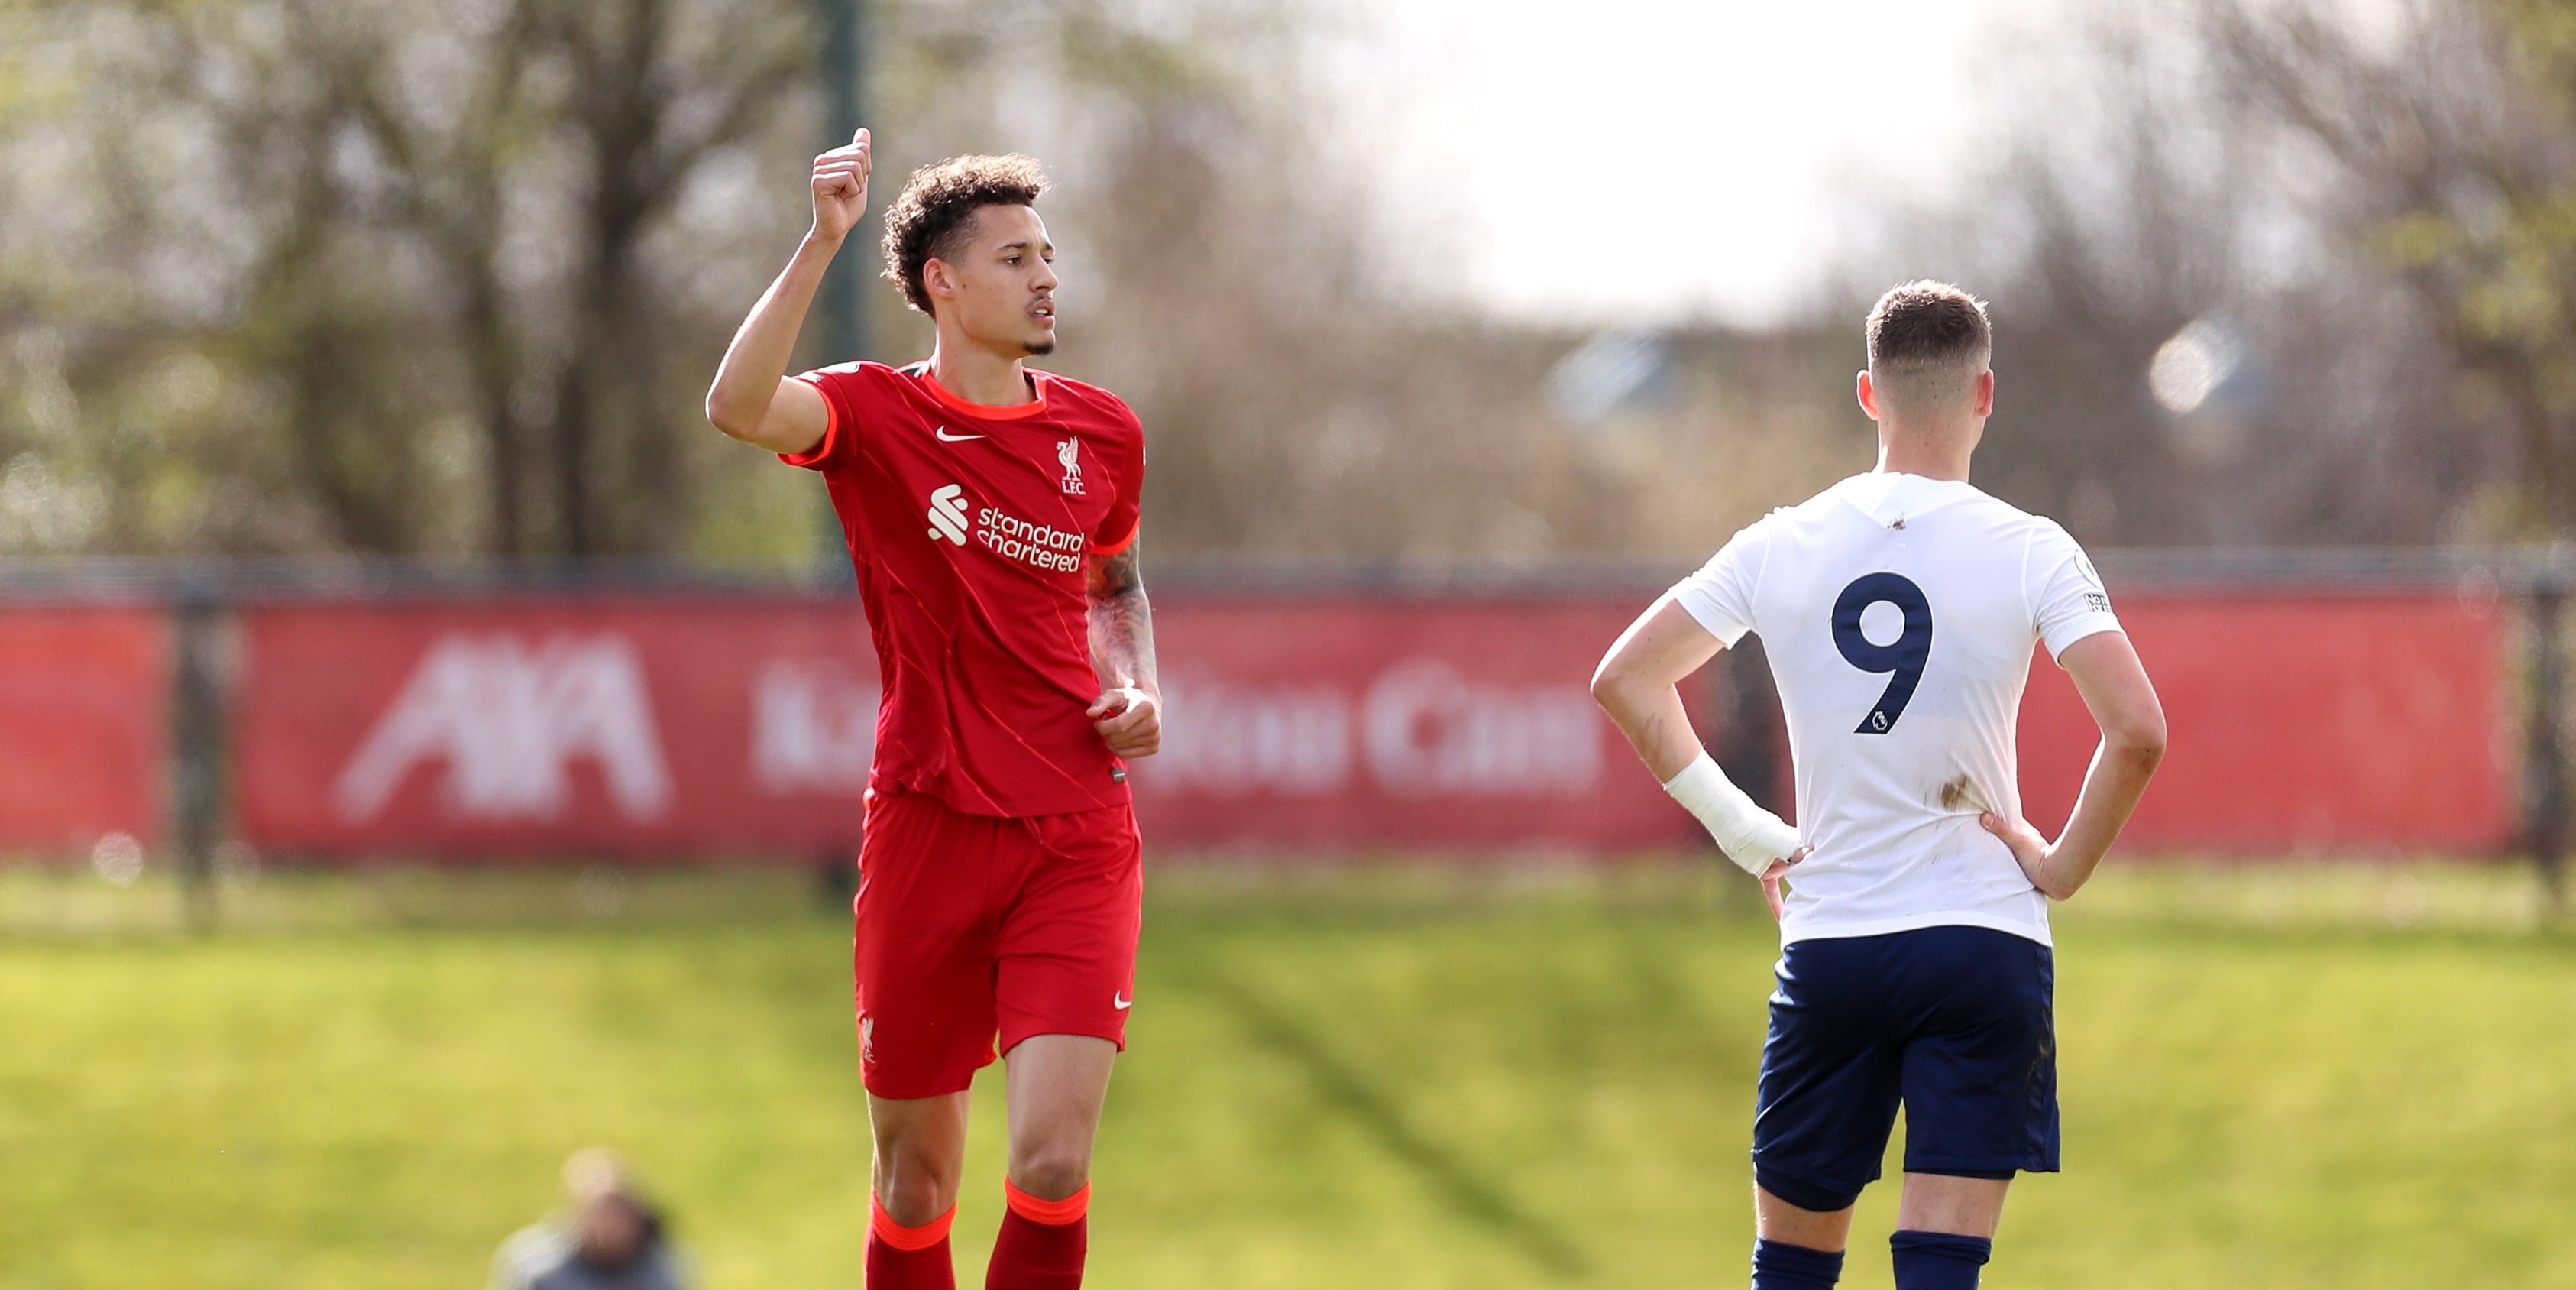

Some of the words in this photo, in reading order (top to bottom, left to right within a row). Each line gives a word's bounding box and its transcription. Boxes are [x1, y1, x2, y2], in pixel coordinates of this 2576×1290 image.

[976, 529, 1081, 572] chartered
[977, 507, 1085, 553] standard
[1831, 571, 1934, 735] 9
